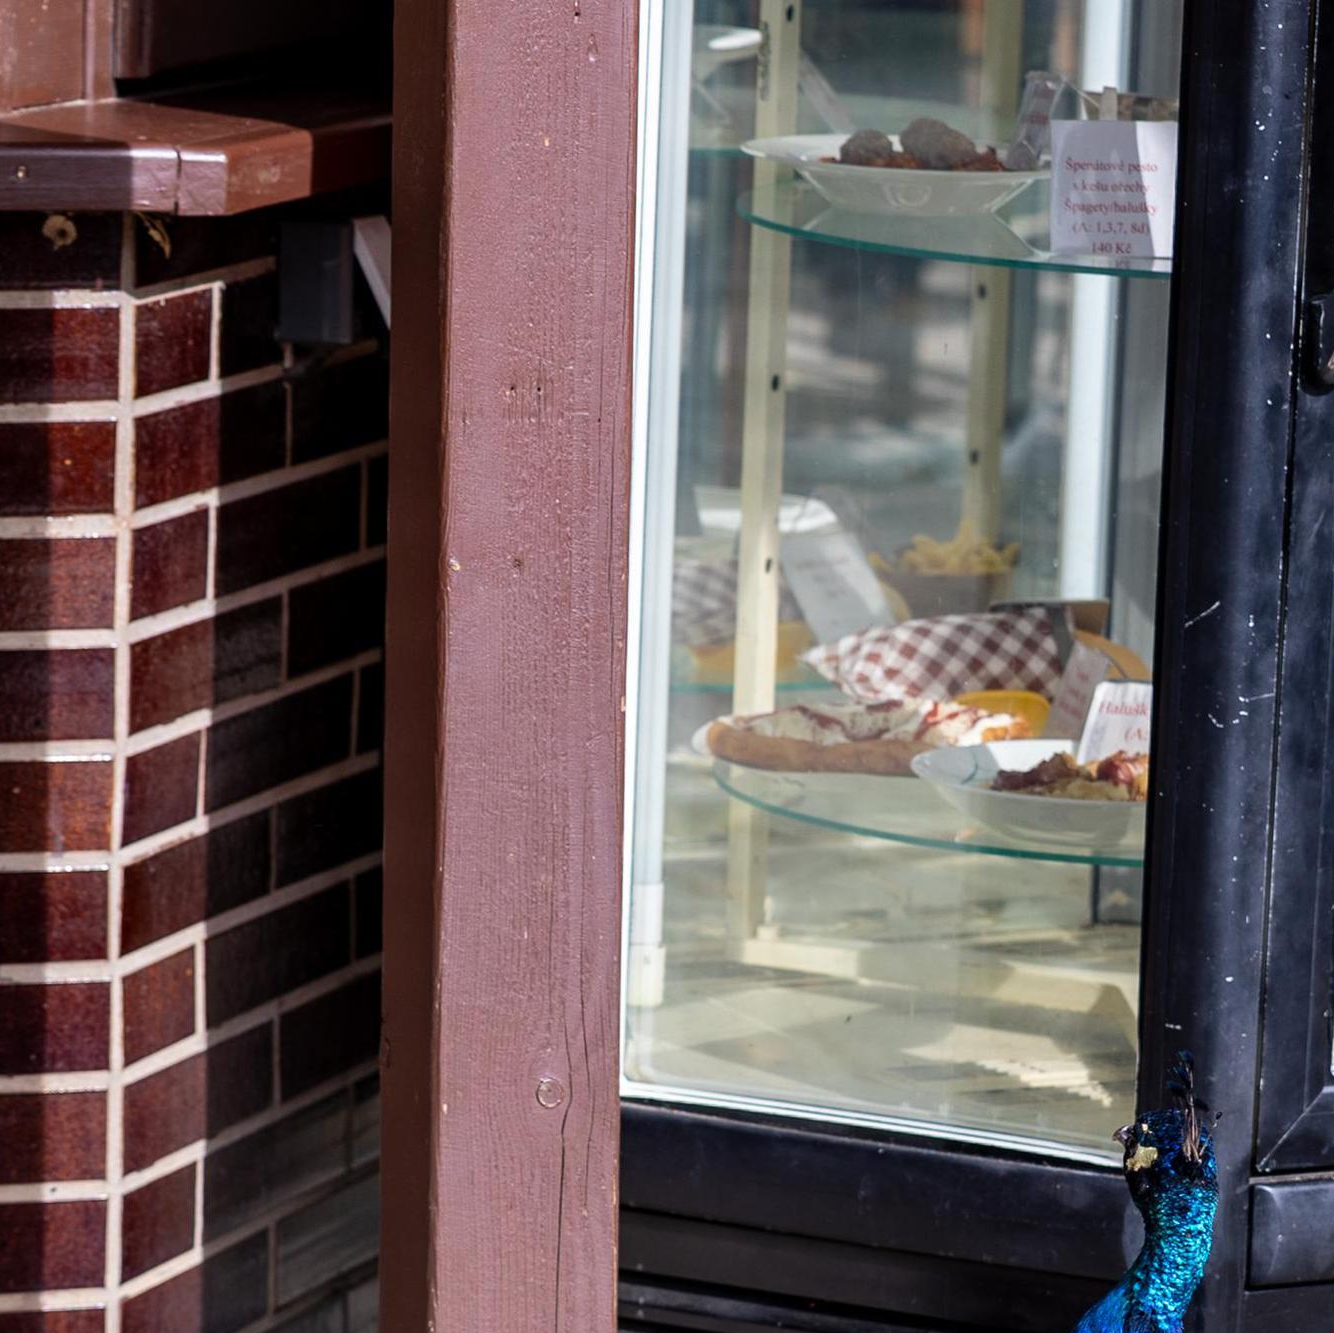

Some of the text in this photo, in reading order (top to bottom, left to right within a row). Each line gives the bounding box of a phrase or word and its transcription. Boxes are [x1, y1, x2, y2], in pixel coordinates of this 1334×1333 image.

[1128, 162, 1157, 174] pesto
[1092, 241, 1132, 254] 140 Kč
